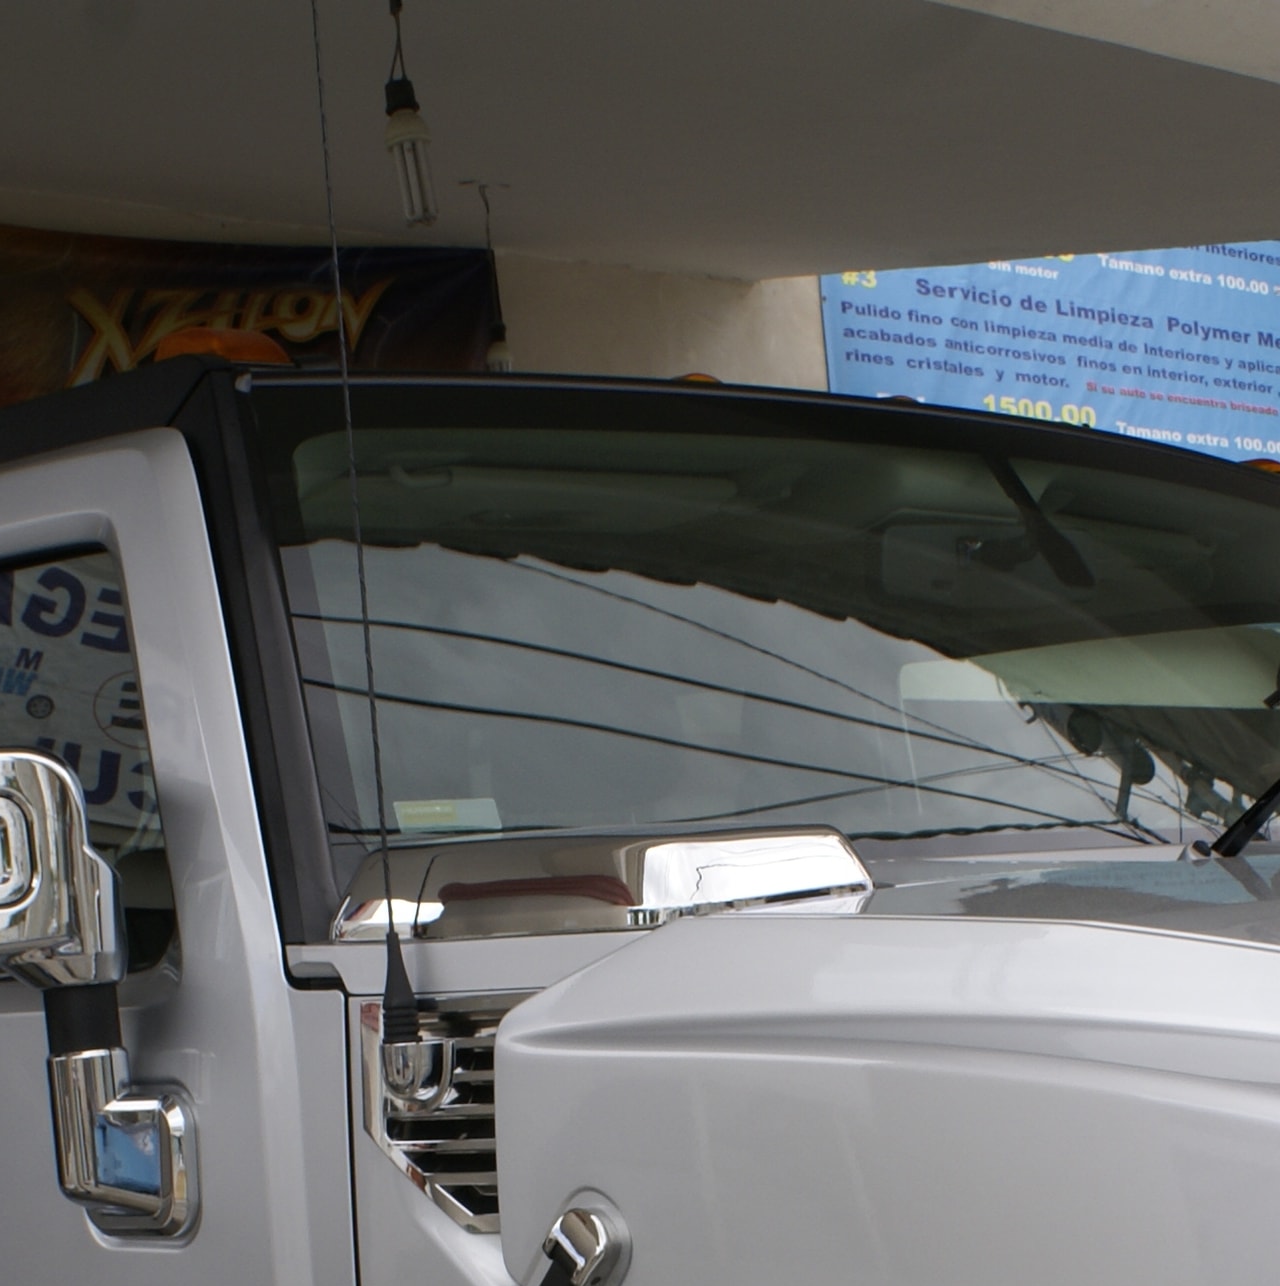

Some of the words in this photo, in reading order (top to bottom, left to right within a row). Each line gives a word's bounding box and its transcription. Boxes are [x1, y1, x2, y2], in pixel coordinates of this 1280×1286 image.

[1015, 264, 1059, 280] motor
[1097, 253, 1164, 277] Tamano
[1169, 268, 1213, 286] extra
[1217, 274, 1269, 295] 100.00
[915, 277, 1013, 308] Servicio
[1020, 294, 1047, 313] de
[1055, 299, 1154, 329] Limpieza
[1166, 316, 1251, 345] Polymer
[841, 301, 902, 320] Pulido
[907, 310, 943, 325] fino
[950, 316, 978, 331] con
[984, 320, 1057, 343] limpieza
[1062, 332, 1114, 351] media
[1118, 341, 1139, 354] de
[1224, 356, 1234, 369] y
[842, 327, 937, 348] acabados
[944, 337, 1067, 365] anticorrosivos
[1076, 355, 1117, 373] finos
[1122, 364, 1143, 376] en
[1213, 376, 1273, 395] exterior
[845, 350, 895, 366] rines
[906, 357, 985, 377] cristales
[995, 368, 1005, 382] y
[1015, 372, 1070, 388] motor.
[983, 393, 1097, 428] 1500.00
[1186, 433, 1229, 448] extra
